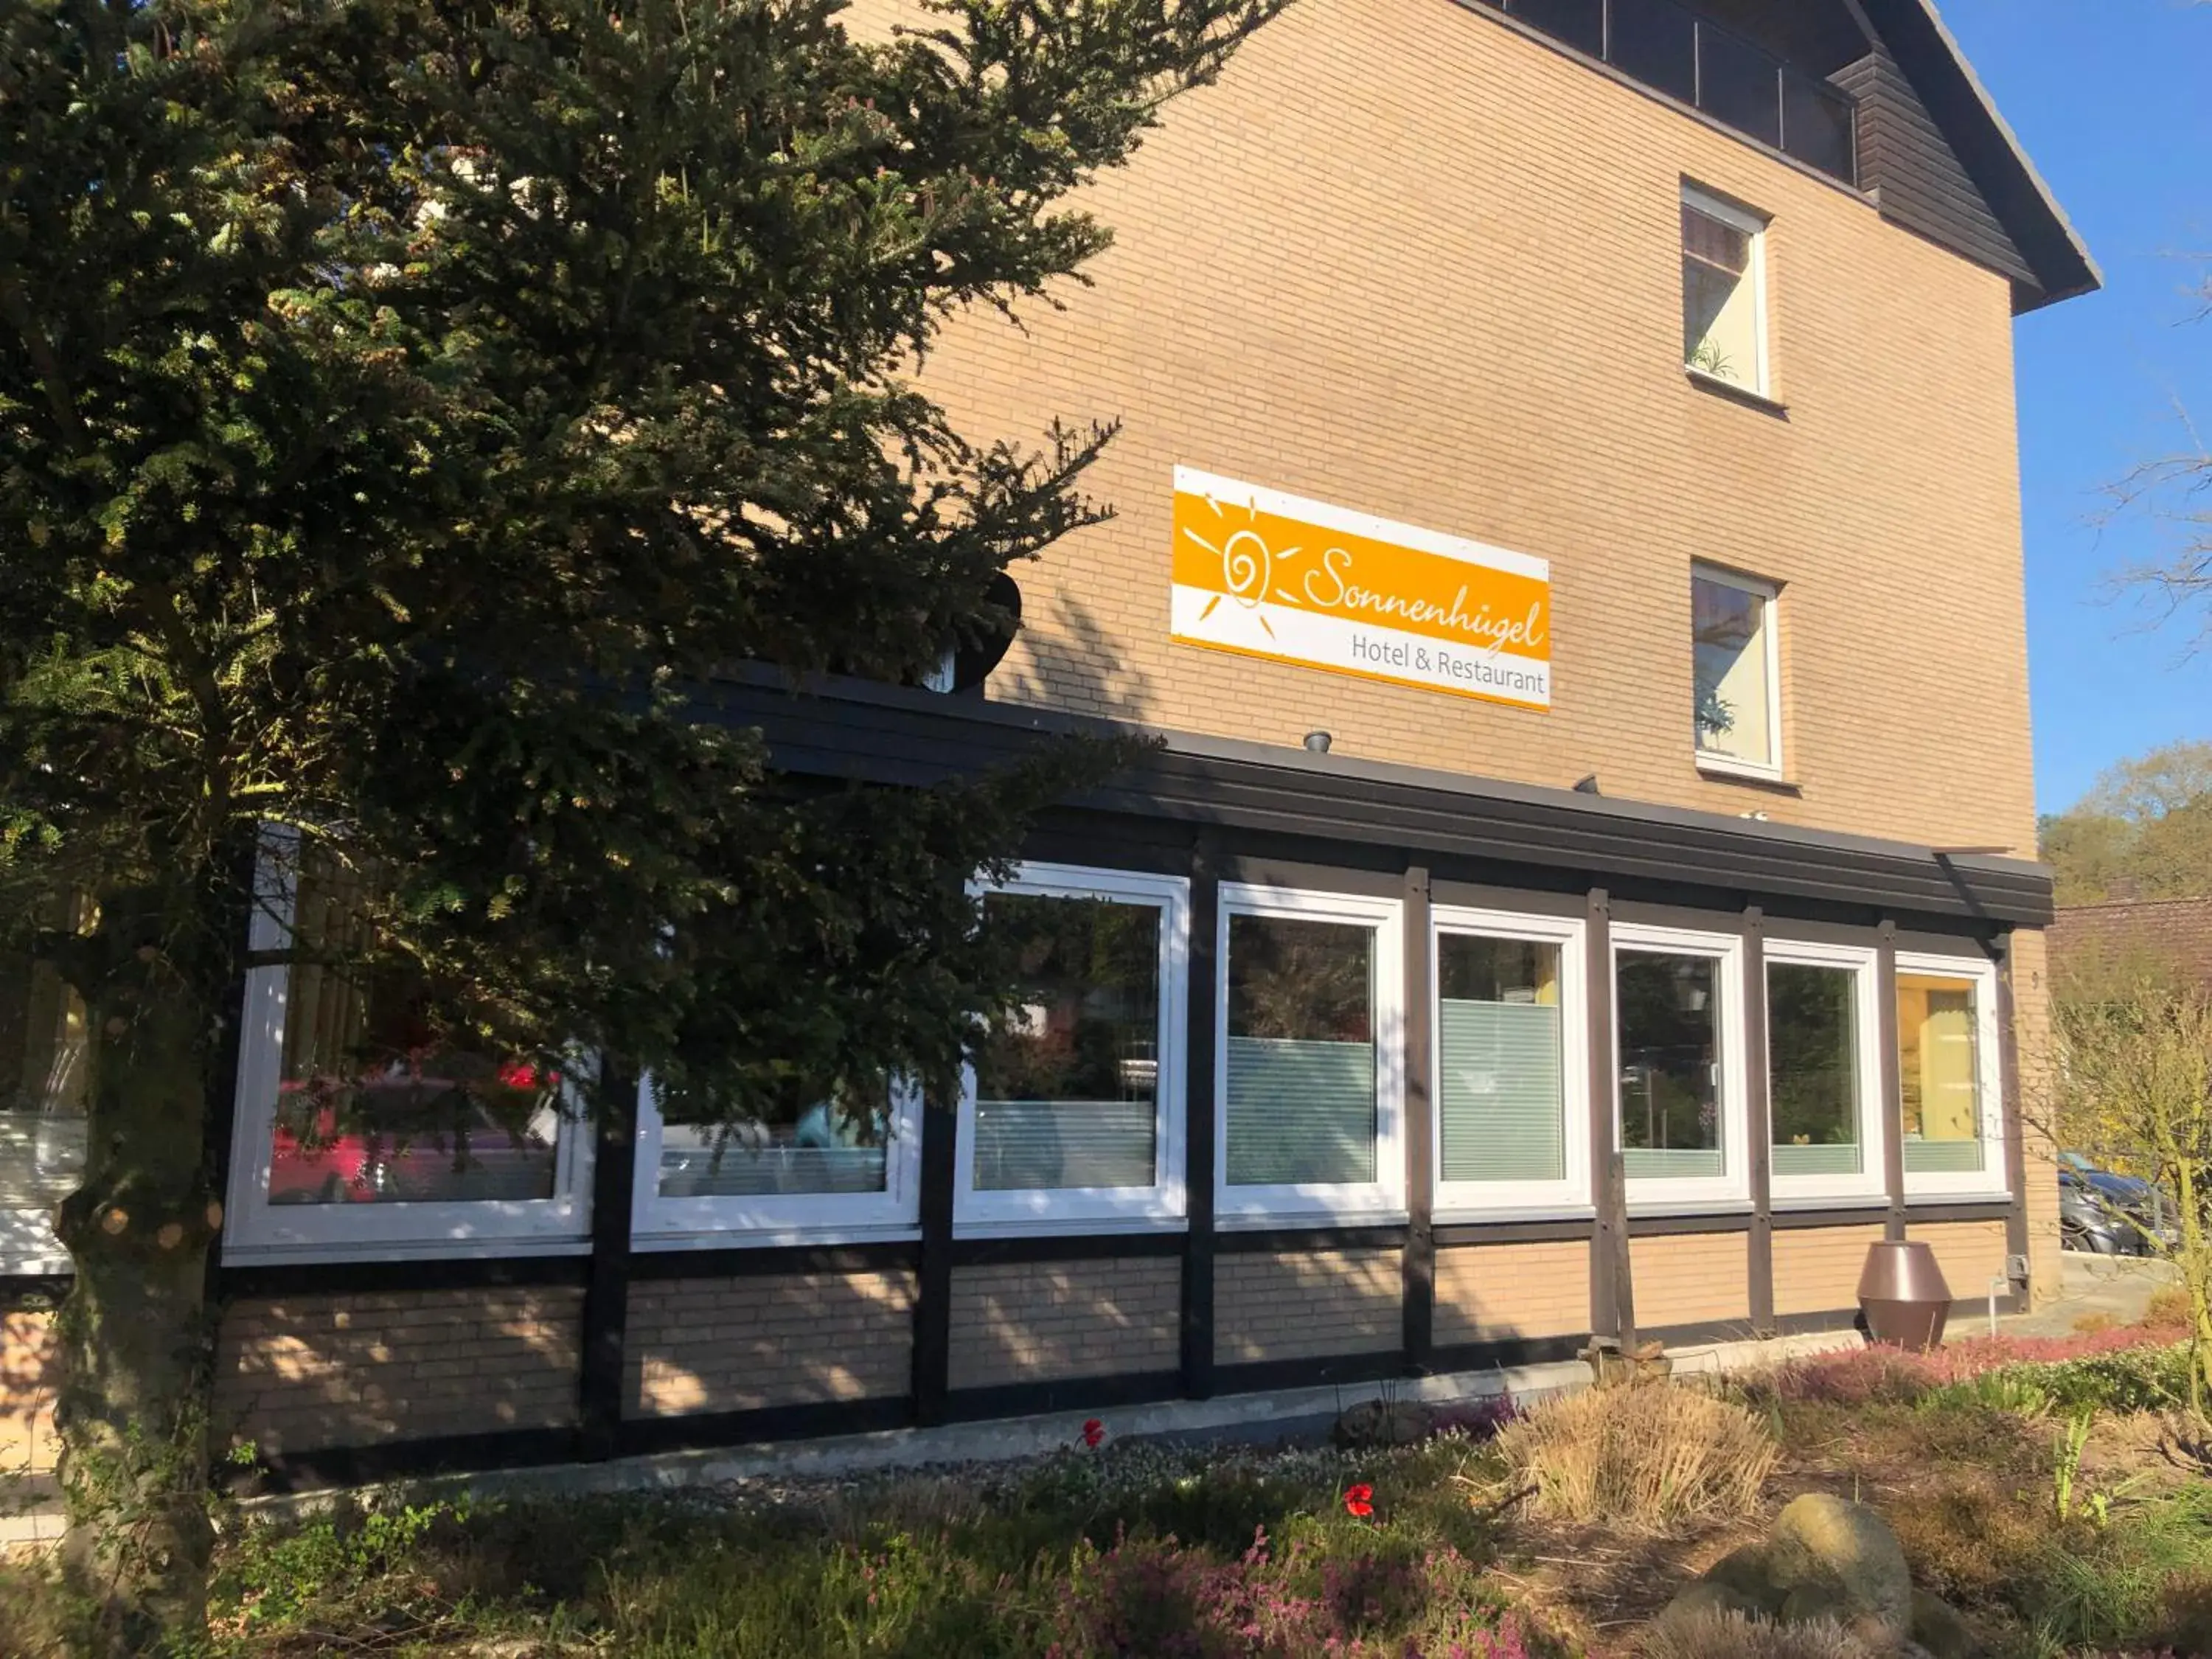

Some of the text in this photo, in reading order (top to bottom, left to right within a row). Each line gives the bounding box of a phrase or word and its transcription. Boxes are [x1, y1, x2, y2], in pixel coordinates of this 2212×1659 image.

[1353, 634, 1545, 694] Hotel & Restaurant
